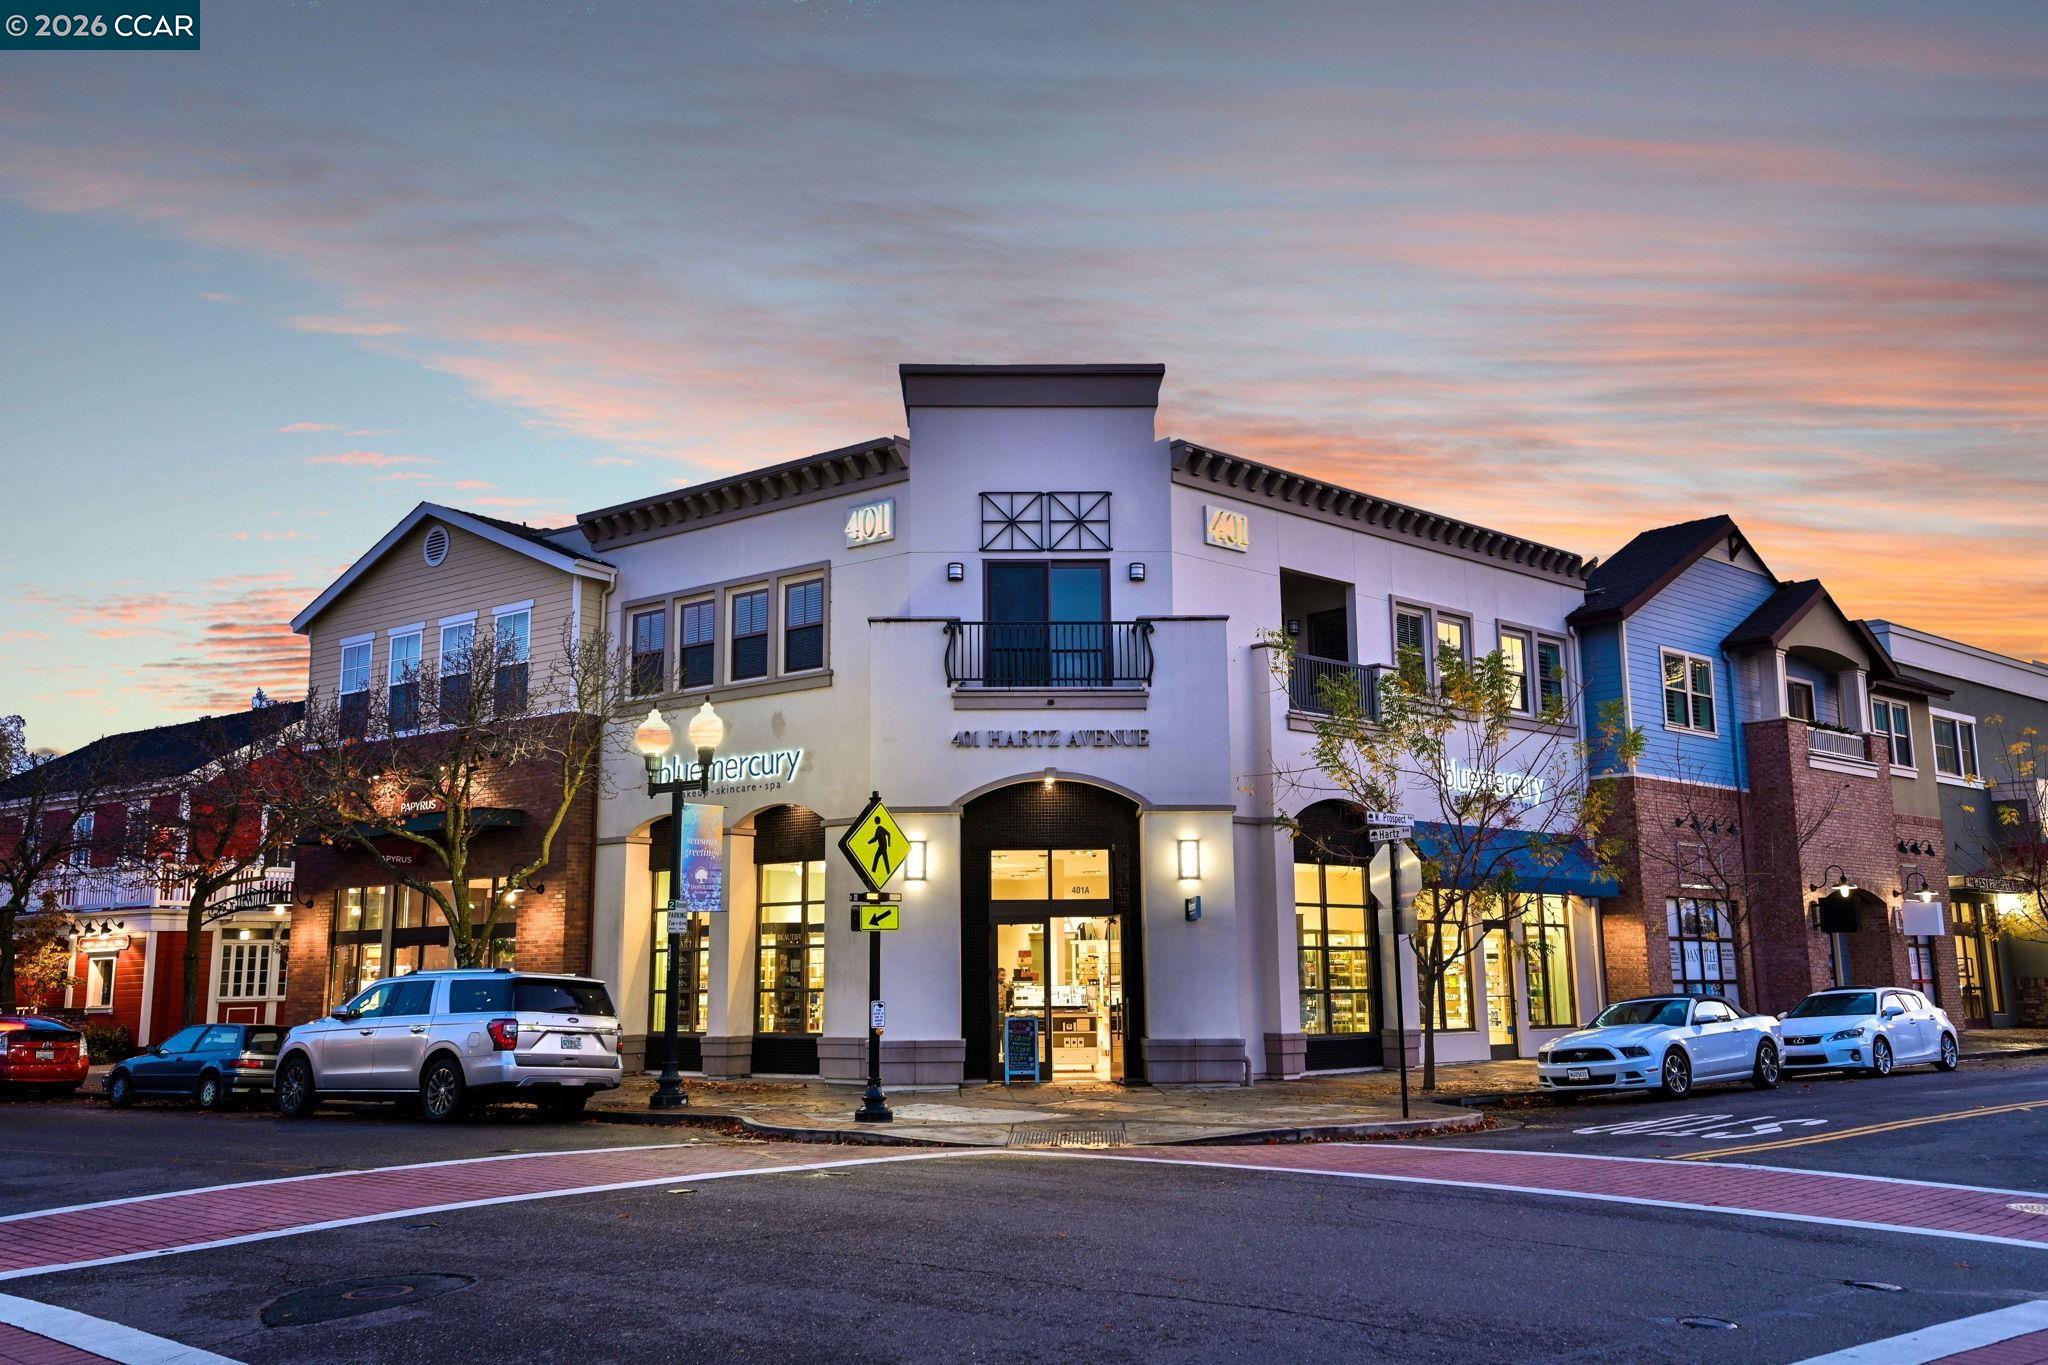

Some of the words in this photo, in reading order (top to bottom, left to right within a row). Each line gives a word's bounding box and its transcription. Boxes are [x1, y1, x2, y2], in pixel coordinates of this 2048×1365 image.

[844, 504, 890, 540] 401
[1208, 510, 1250, 547] 401
[951, 729, 981, 749] 401
[988, 729, 1061, 749] HARTZ
[1066, 729, 1150, 748] AVENUE
[659, 749, 801, 785] bluemercury
[681, 789, 708, 799] akeup
[716, 784, 757, 796] skincare
[765, 781, 781, 793] spa
[400, 799, 437, 813] PAPYRUS
[1382, 812, 1407, 824] Prospect
[1379, 829, 1400, 839] Hartz
[683, 846, 720, 860] greetings
[1071, 885, 1090, 895] 401A
[669, 901, 675, 909] 2
